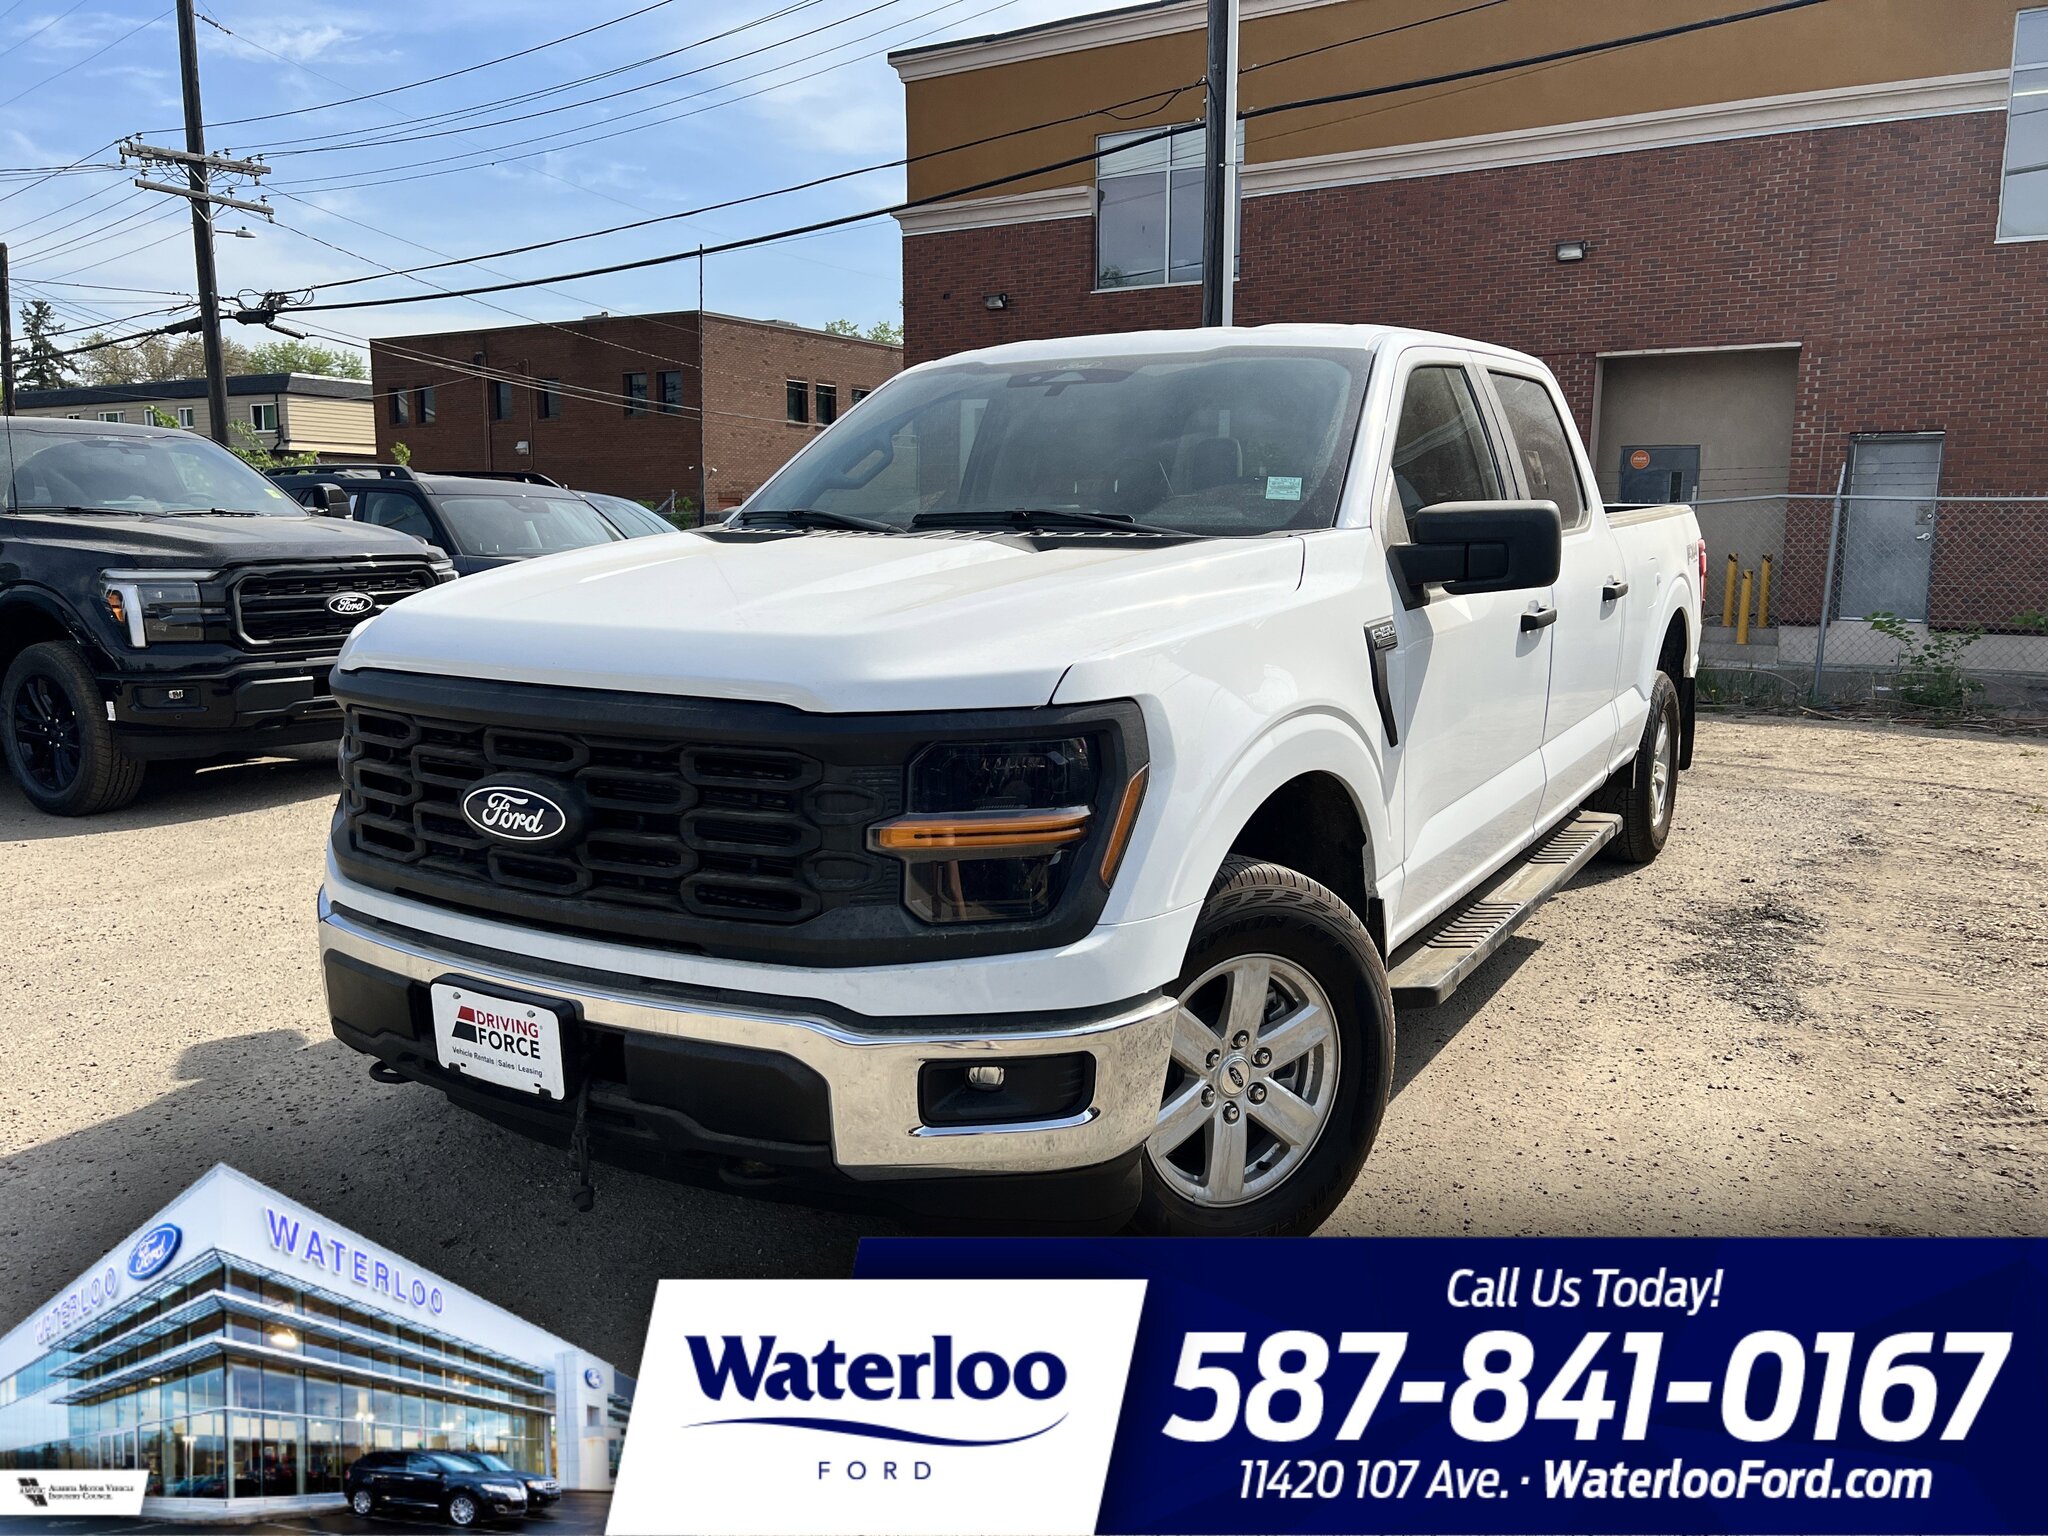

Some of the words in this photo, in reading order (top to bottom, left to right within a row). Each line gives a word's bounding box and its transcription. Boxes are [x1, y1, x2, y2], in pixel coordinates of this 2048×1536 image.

[337, 597, 365, 611] Ford
[482, 792, 544, 833] Ford
[476, 1010, 539, 1039] DRIVING
[478, 1026, 541, 1060] FORCE
[452, 1046, 473, 1058] Vehicle
[473, 1052, 496, 1065] Rentals
[497, 1059, 516, 1070] Sales
[517, 1064, 544, 1078] Leasing
